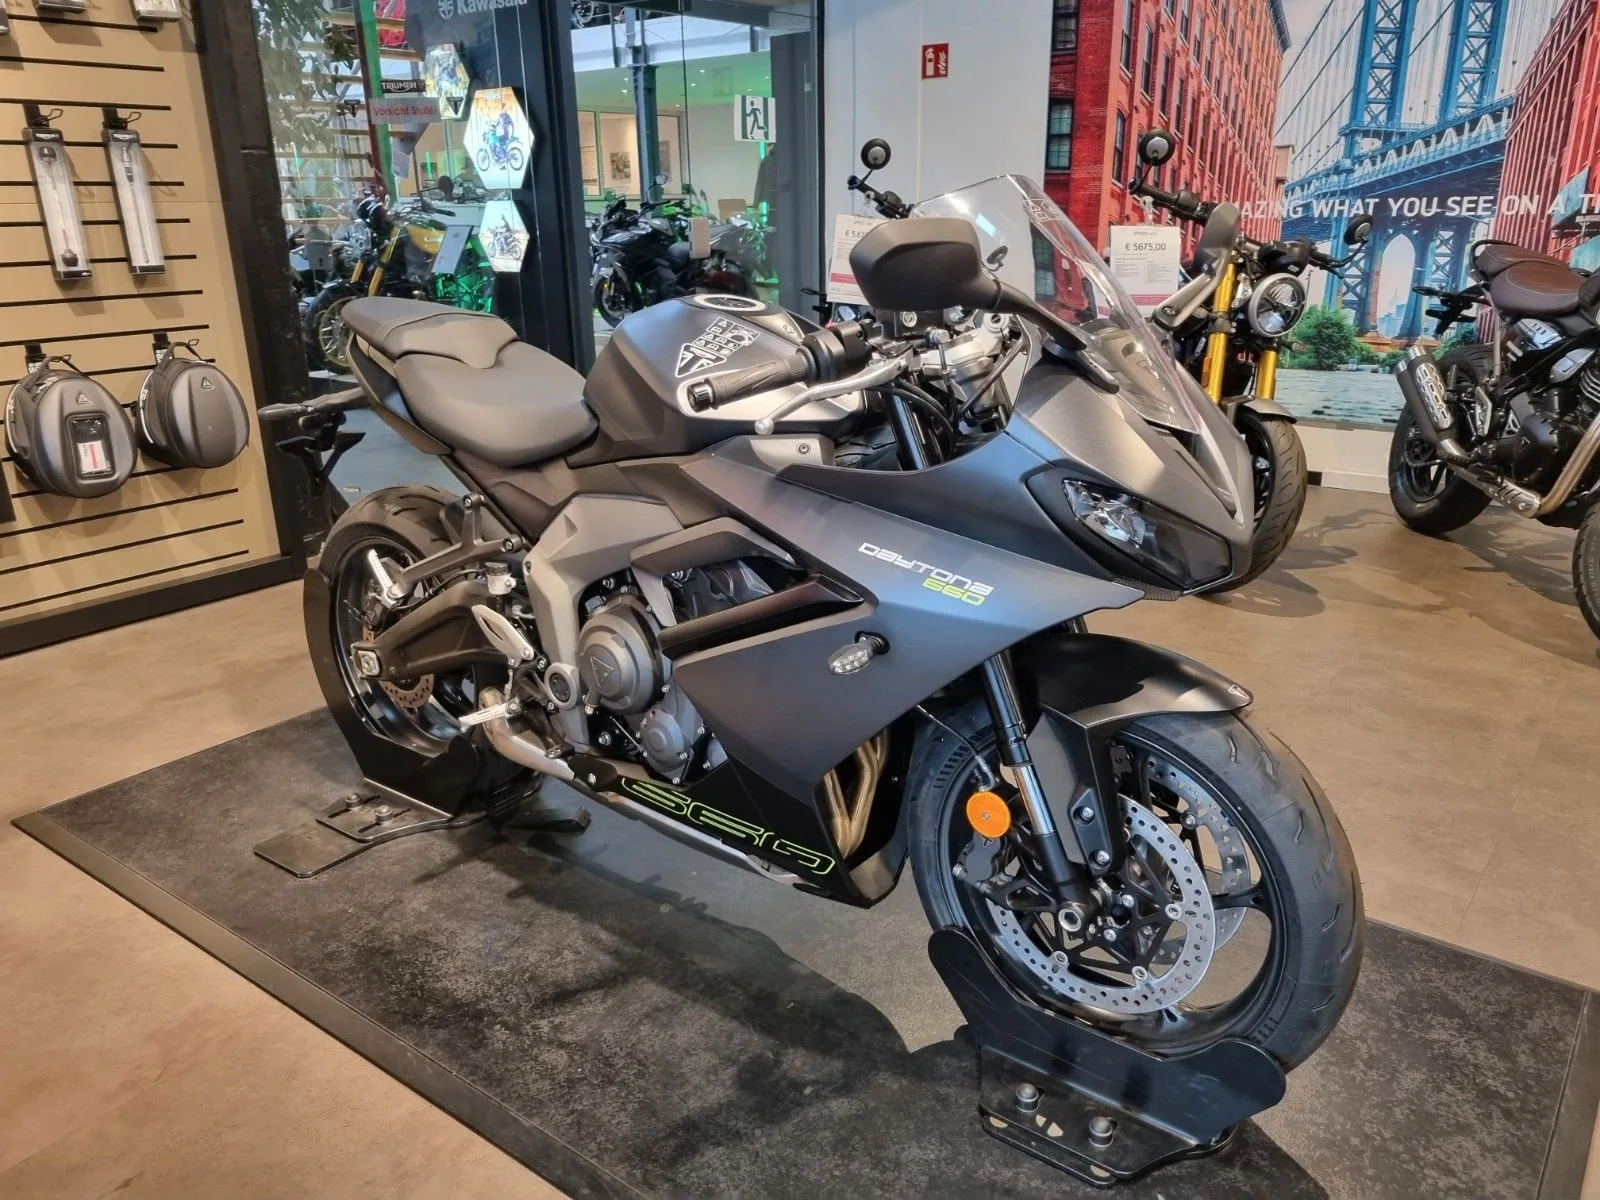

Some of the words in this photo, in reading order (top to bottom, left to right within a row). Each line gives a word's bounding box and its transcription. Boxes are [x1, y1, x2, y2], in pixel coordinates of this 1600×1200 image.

[382, 81, 417, 92] TRIUMPH
[374, 105, 409, 116] Vorsicht
[412, 104, 432, 115] Stufe
[1233, 200, 1303, 218] AZING
[1312, 198, 1379, 218] WHAT
[1388, 197, 1439, 217] YOU
[1445, 196, 1494, 217] SEE
[1501, 195, 1540, 215] ON
[1547, 194, 1566, 214] A
[1133, 243, 1167, 252] 5675,00
[922, 577, 985, 607] 660
